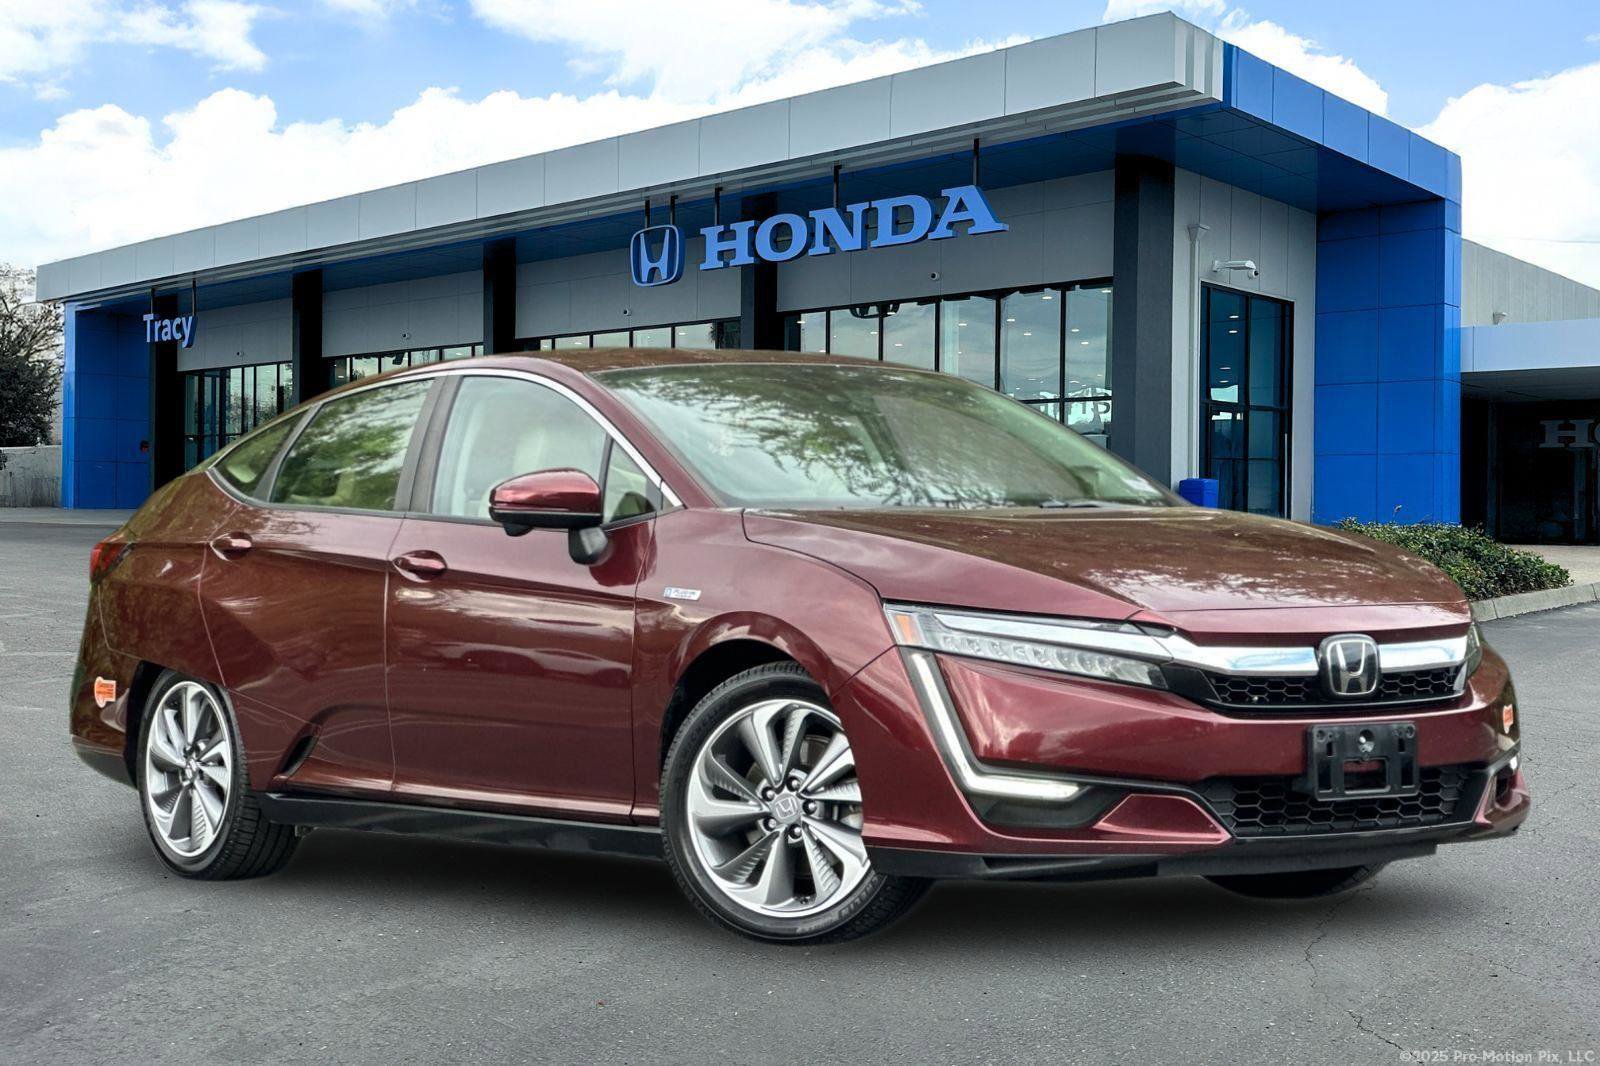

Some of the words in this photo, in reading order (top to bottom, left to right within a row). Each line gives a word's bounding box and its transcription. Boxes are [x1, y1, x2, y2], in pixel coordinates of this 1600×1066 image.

[700, 184, 1010, 271] HONDA
[142, 313, 194, 348] Tracy
[1539, 419, 1600, 448] H
